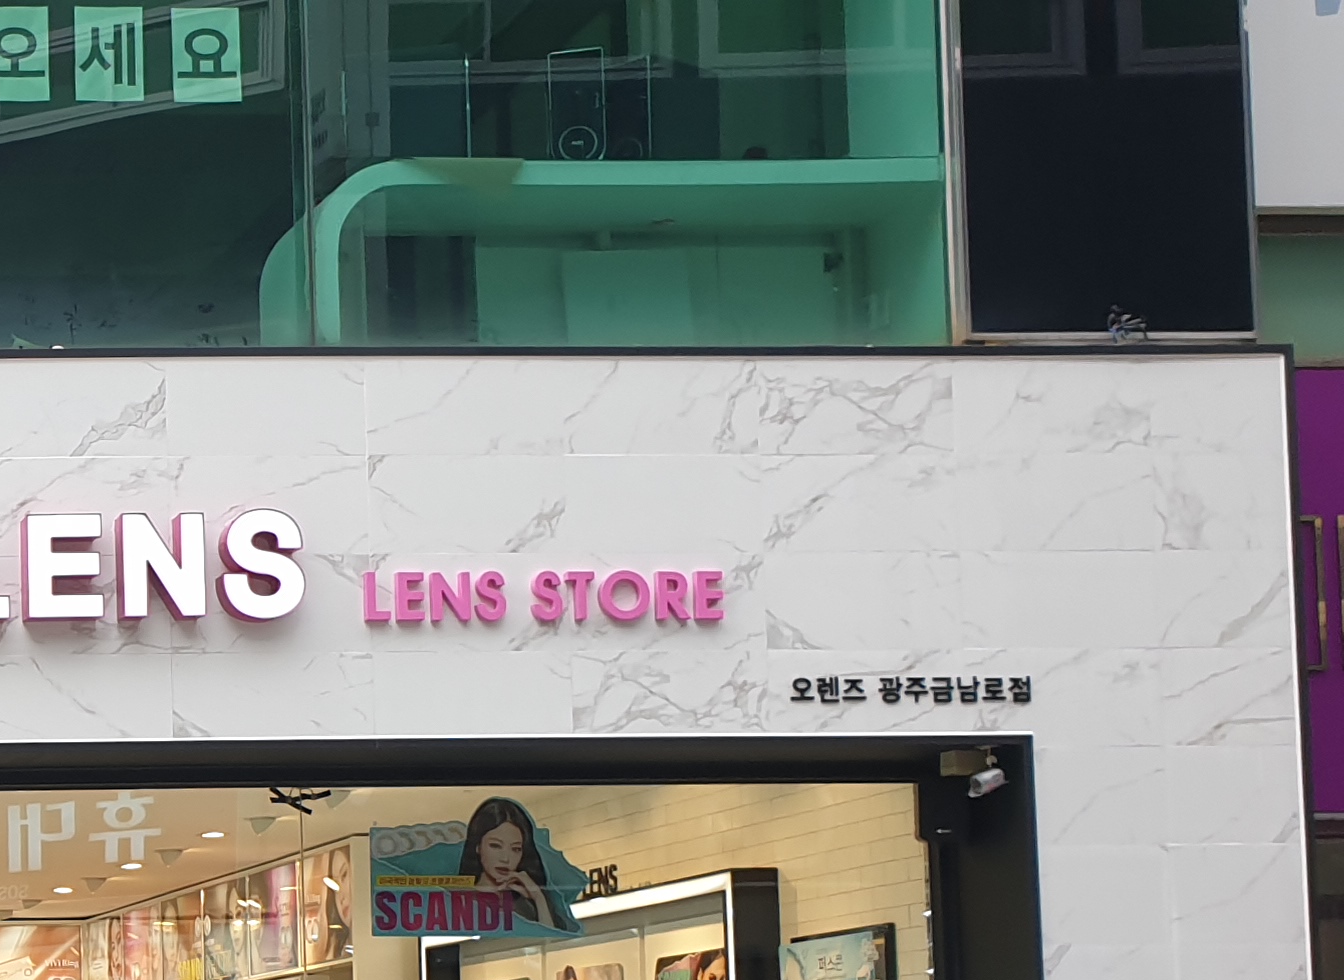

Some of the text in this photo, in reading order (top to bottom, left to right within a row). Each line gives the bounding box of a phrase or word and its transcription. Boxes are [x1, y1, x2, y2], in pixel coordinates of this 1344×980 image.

[362, 570, 726, 625] LENS STORE
[790, 675, 1032, 705] 오렌즈 광주금남로점
[375, 890, 513, 932] SCANDI
